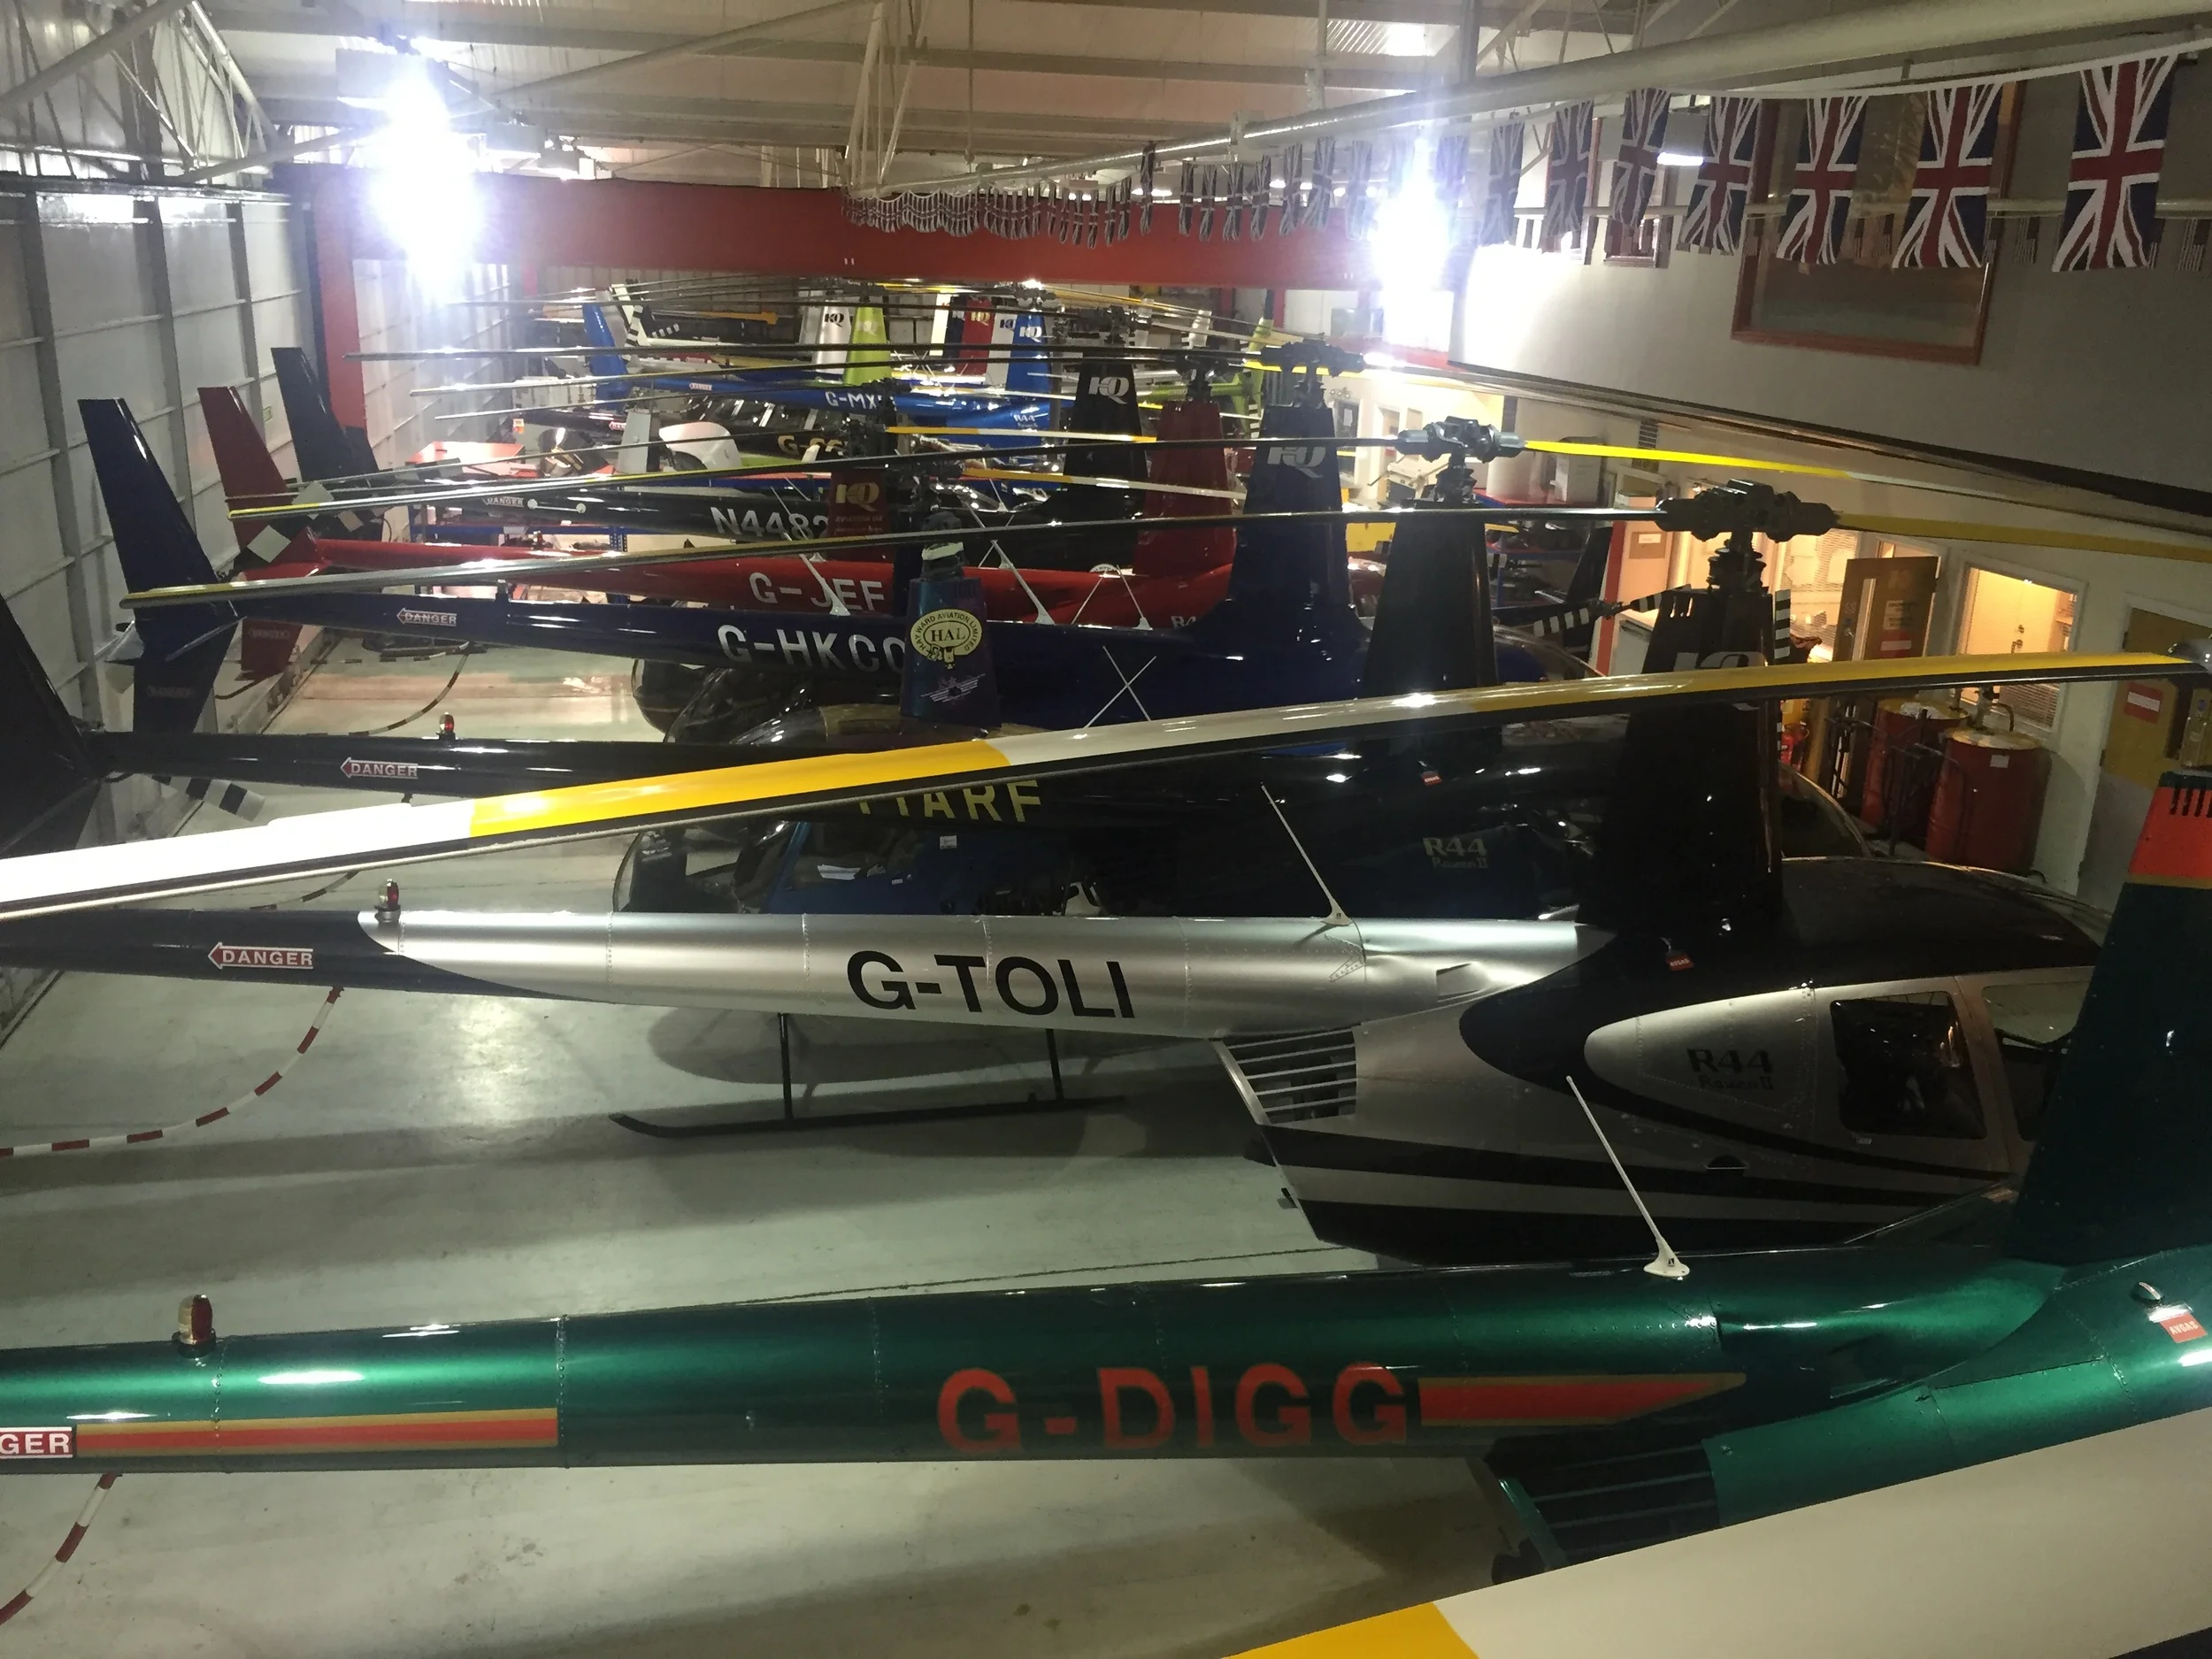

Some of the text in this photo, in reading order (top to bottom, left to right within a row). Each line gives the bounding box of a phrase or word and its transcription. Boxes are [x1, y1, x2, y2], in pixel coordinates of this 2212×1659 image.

[404, 612, 457, 625] DANGER
[930, 627, 966, 642] HAL
[350, 764, 418, 777] DANGER
[1423, 837, 1487, 856] R44
[222, 949, 312, 966] DANGER
[847, 950, 1135, 1018] G-TOLI
[1686, 1048, 1773, 1073] R44
[2169, 1320, 2199, 1335] AVGAS
